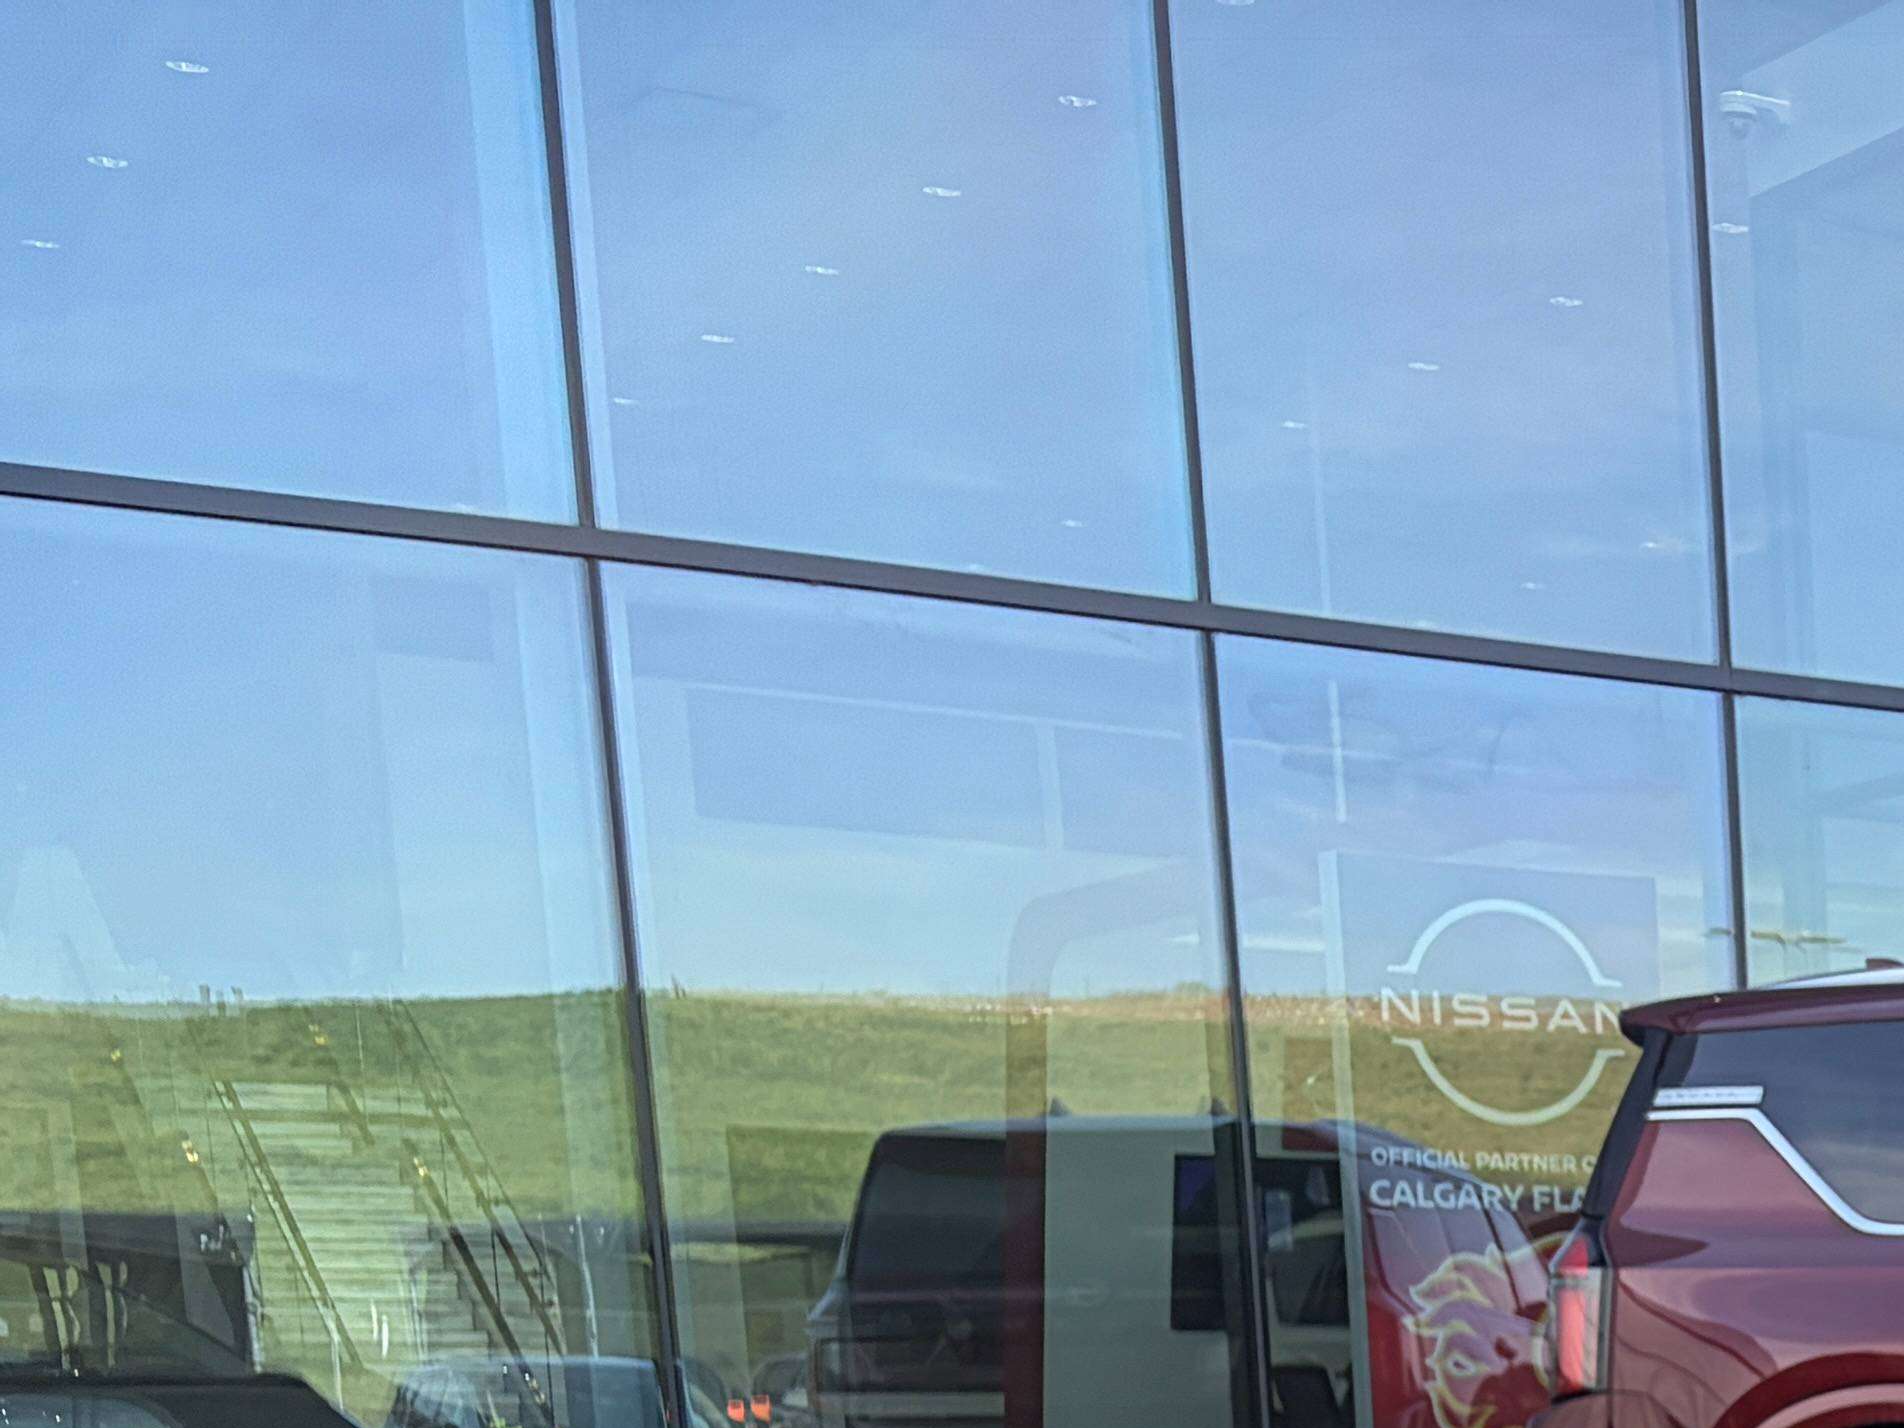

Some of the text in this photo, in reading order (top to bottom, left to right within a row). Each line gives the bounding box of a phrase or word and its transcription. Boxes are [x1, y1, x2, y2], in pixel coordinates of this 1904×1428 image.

[1380, 986, 1620, 1036] NISSAN
[1370, 1146, 1471, 1171] OFFICIAL
[1475, 1151, 1578, 1175] PARTNER
[1368, 1178, 1588, 1214] CALGARY FLA
